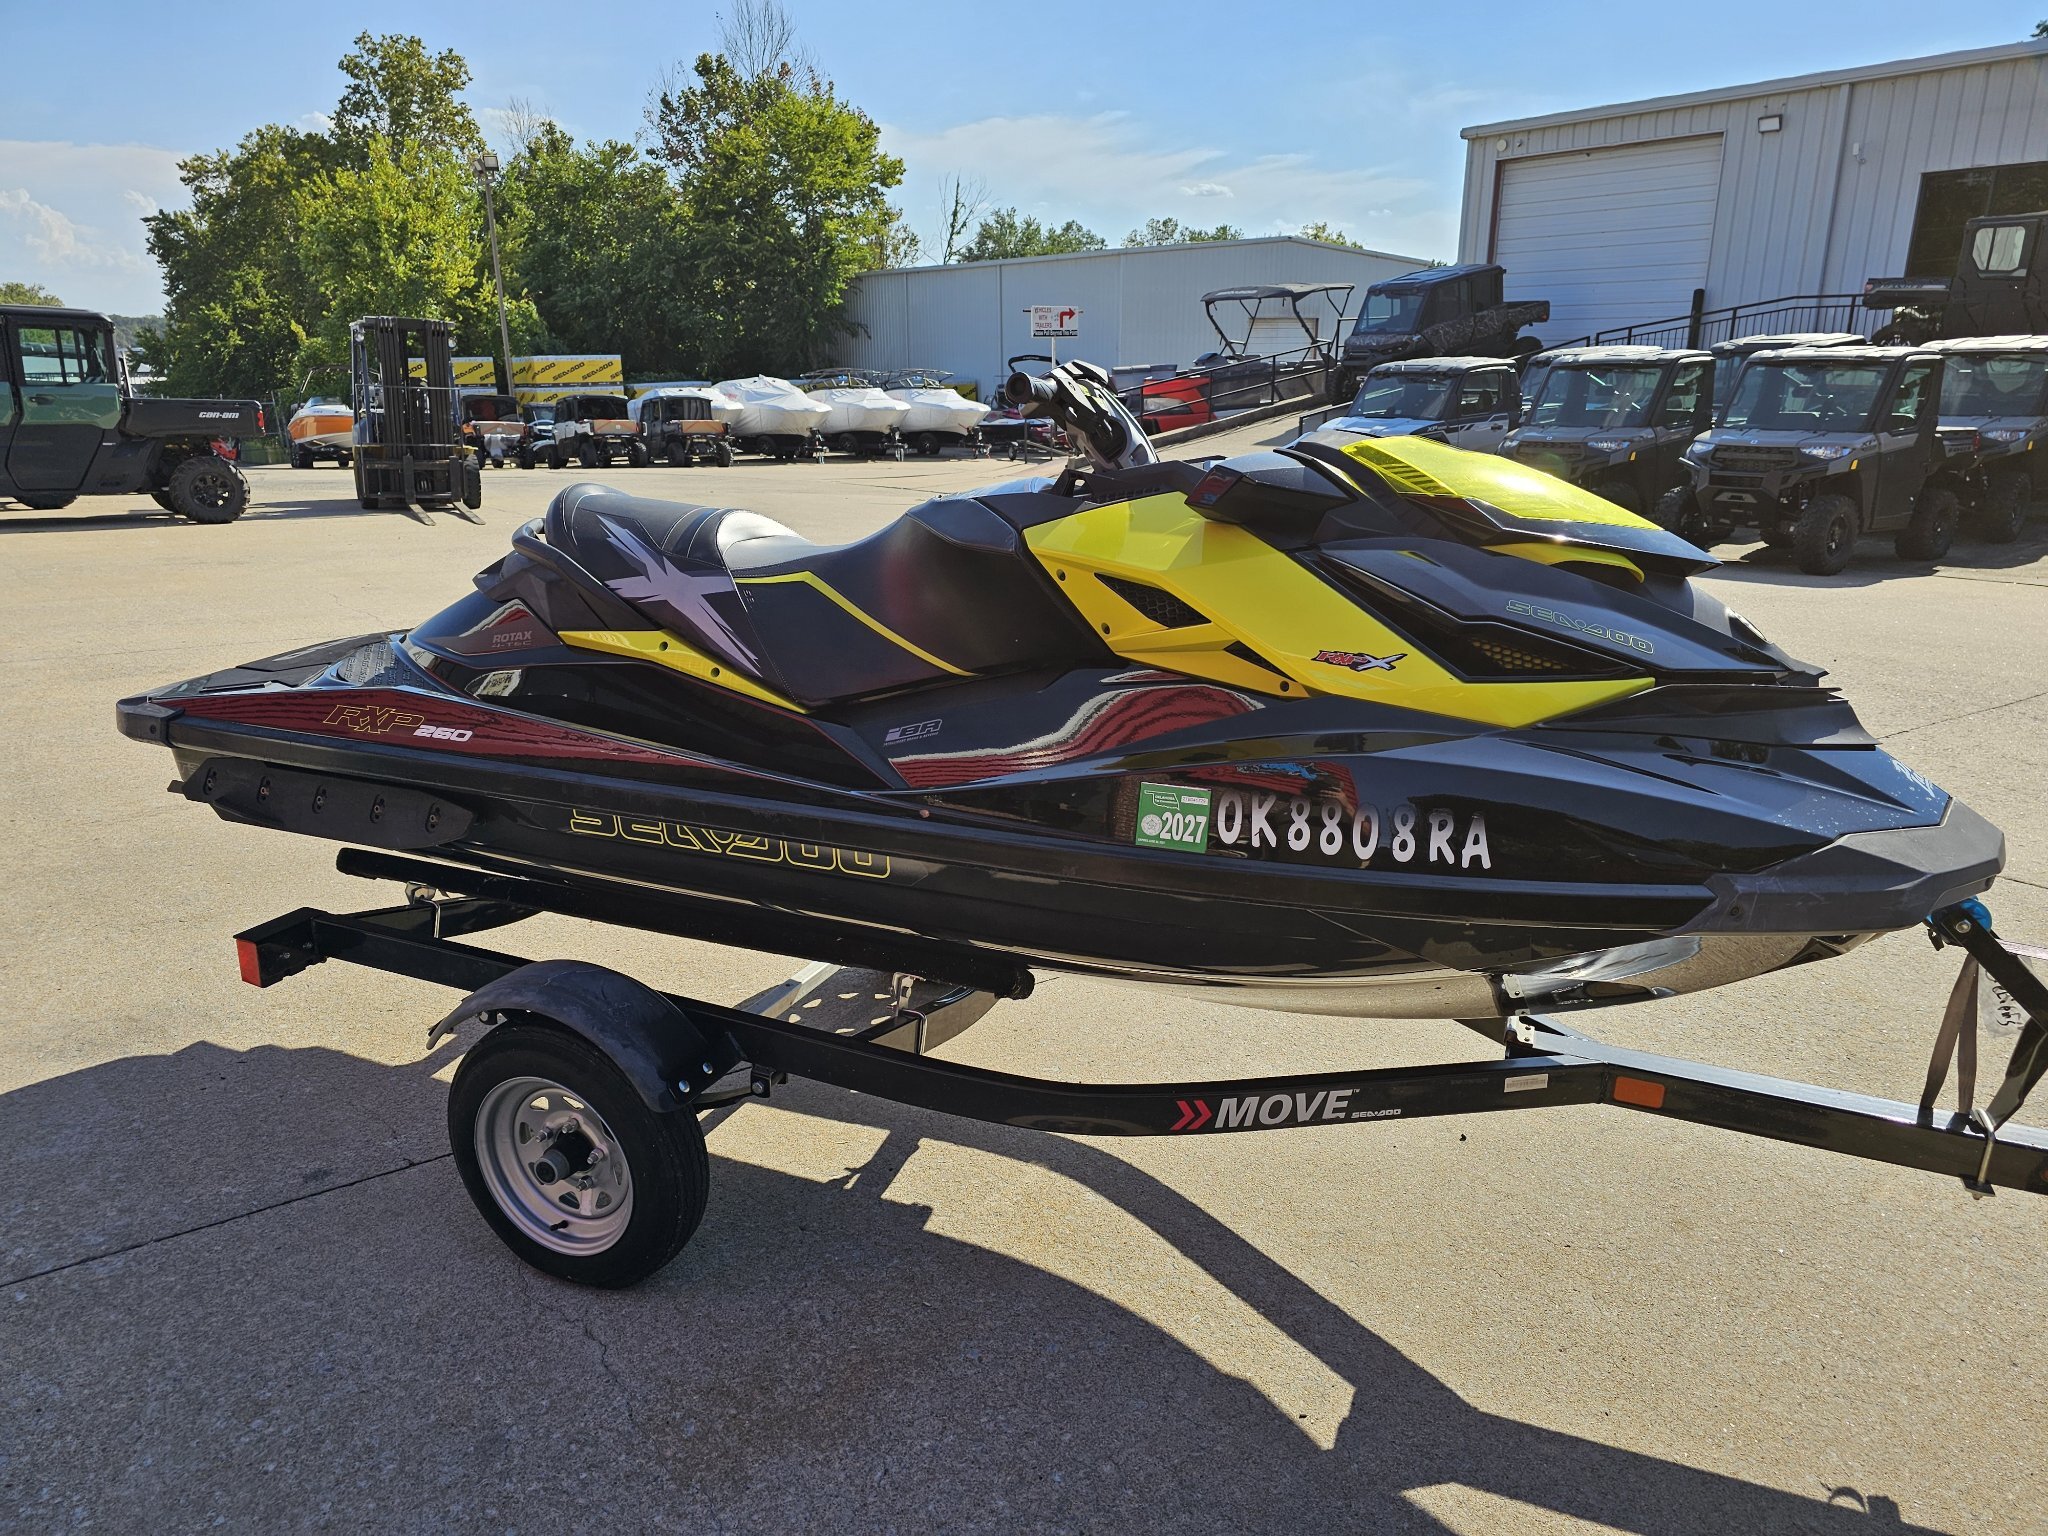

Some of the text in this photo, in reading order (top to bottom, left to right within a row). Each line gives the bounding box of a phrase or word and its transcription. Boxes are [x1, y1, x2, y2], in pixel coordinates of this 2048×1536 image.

[492, 631, 533, 644] ROTAX
[323, 704, 474, 742] RXP 260
[1160, 811, 1207, 844] 2027
[1215, 1089, 1353, 1129] MOVE
